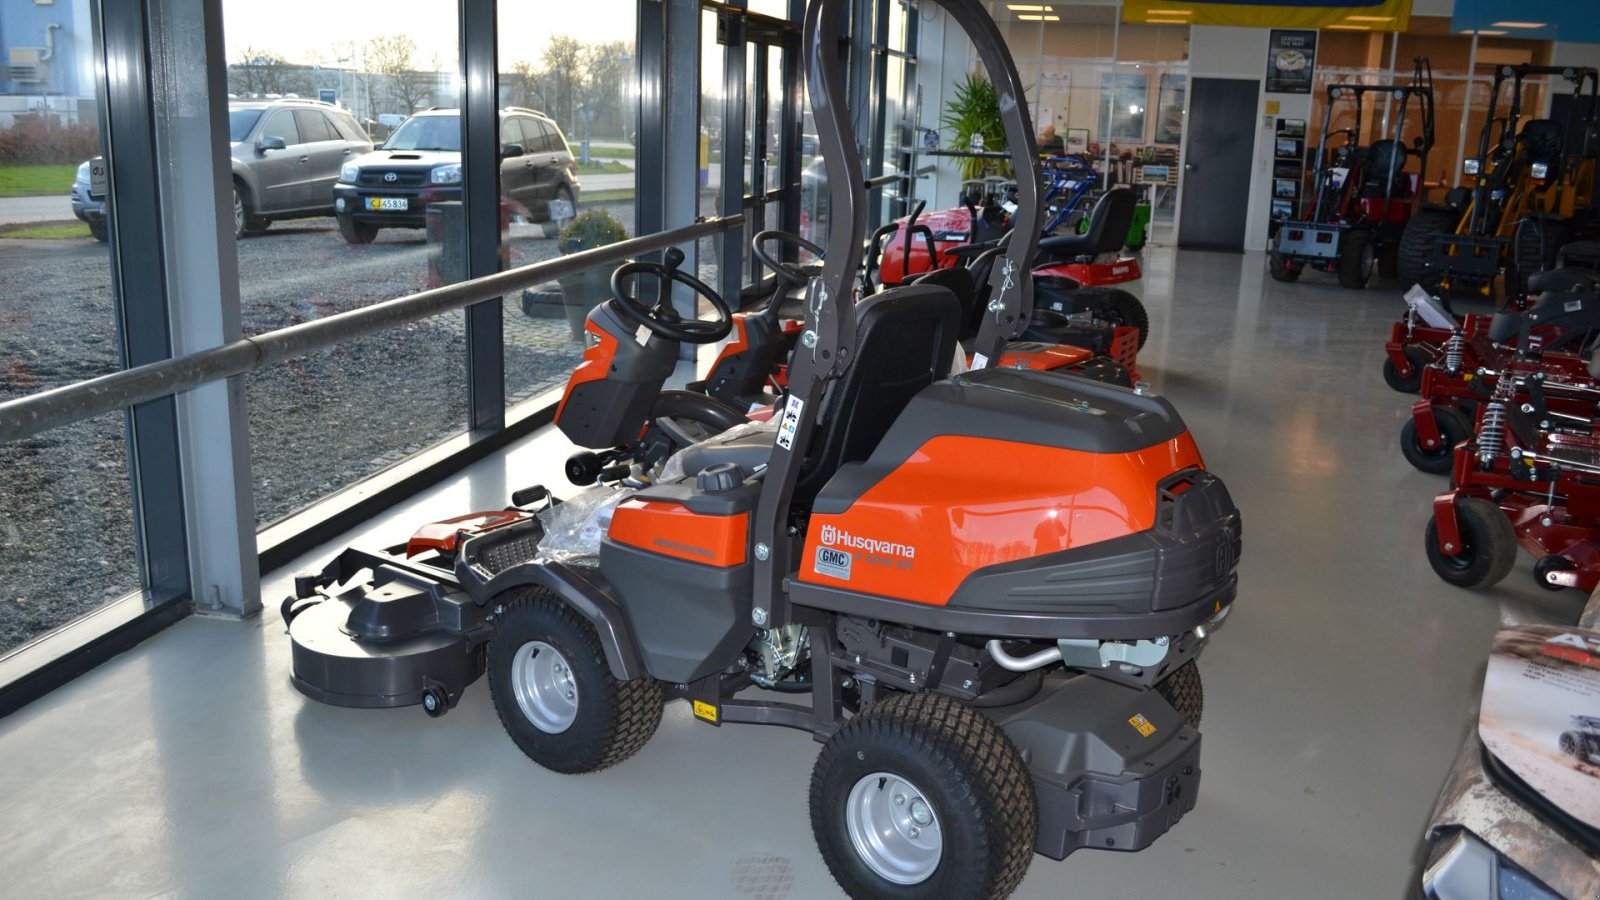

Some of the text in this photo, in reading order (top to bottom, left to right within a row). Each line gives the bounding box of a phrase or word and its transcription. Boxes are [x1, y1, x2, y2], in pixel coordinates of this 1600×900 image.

[371, 199, 381, 208] CJ
[836, 530, 915, 558] Husqvarna
[822, 550, 846, 566] GMC
